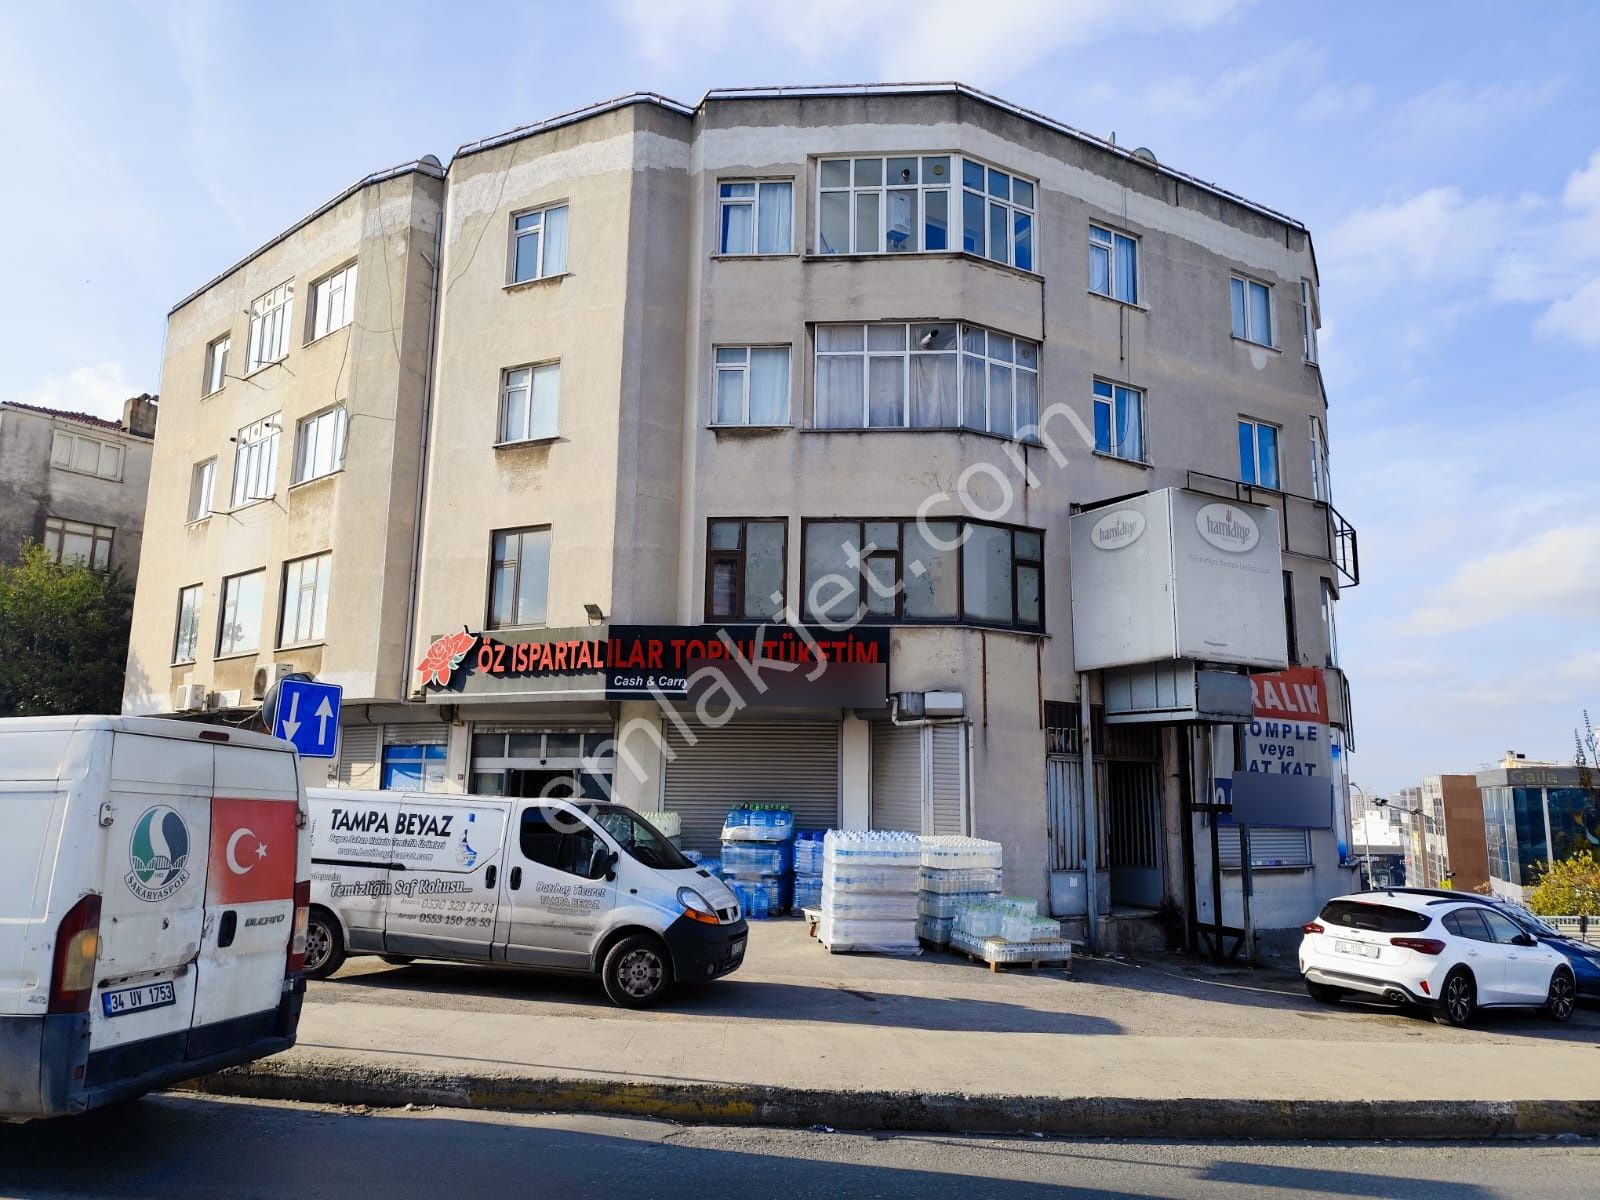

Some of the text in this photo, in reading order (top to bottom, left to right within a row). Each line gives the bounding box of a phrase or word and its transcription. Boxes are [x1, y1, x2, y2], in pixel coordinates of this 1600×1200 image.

[477, 637, 505, 673] ÖZ
[763, 632, 878, 664] TÜKETİM
[614, 675, 688, 689] Cash & Carry
[1246, 721, 1317, 742] OMPLE
[1260, 743, 1295, 760] veya
[331, 809, 389, 834] TAMPA
[395, 812, 454, 837] BEYAZ
[127, 874, 187, 900] SAKARYASPOR
[331, 880, 392, 899] Temizliğin
[394, 879, 419, 898] Saf
[421, 899, 443, 911] 0530
[448, 900, 465, 912] 329
[469, 901, 481, 912] 37
[483, 903, 495, 914] 34
[540, 896, 600, 909] TAMPA BEYAZ
[419, 913, 442, 924] 0553
[445, 914, 463, 925] 150
[465, 915, 477, 926] 25
[479, 916, 491, 928] 53
[111, 994, 125, 1010] 34
[149, 985, 172, 1003] 1753
